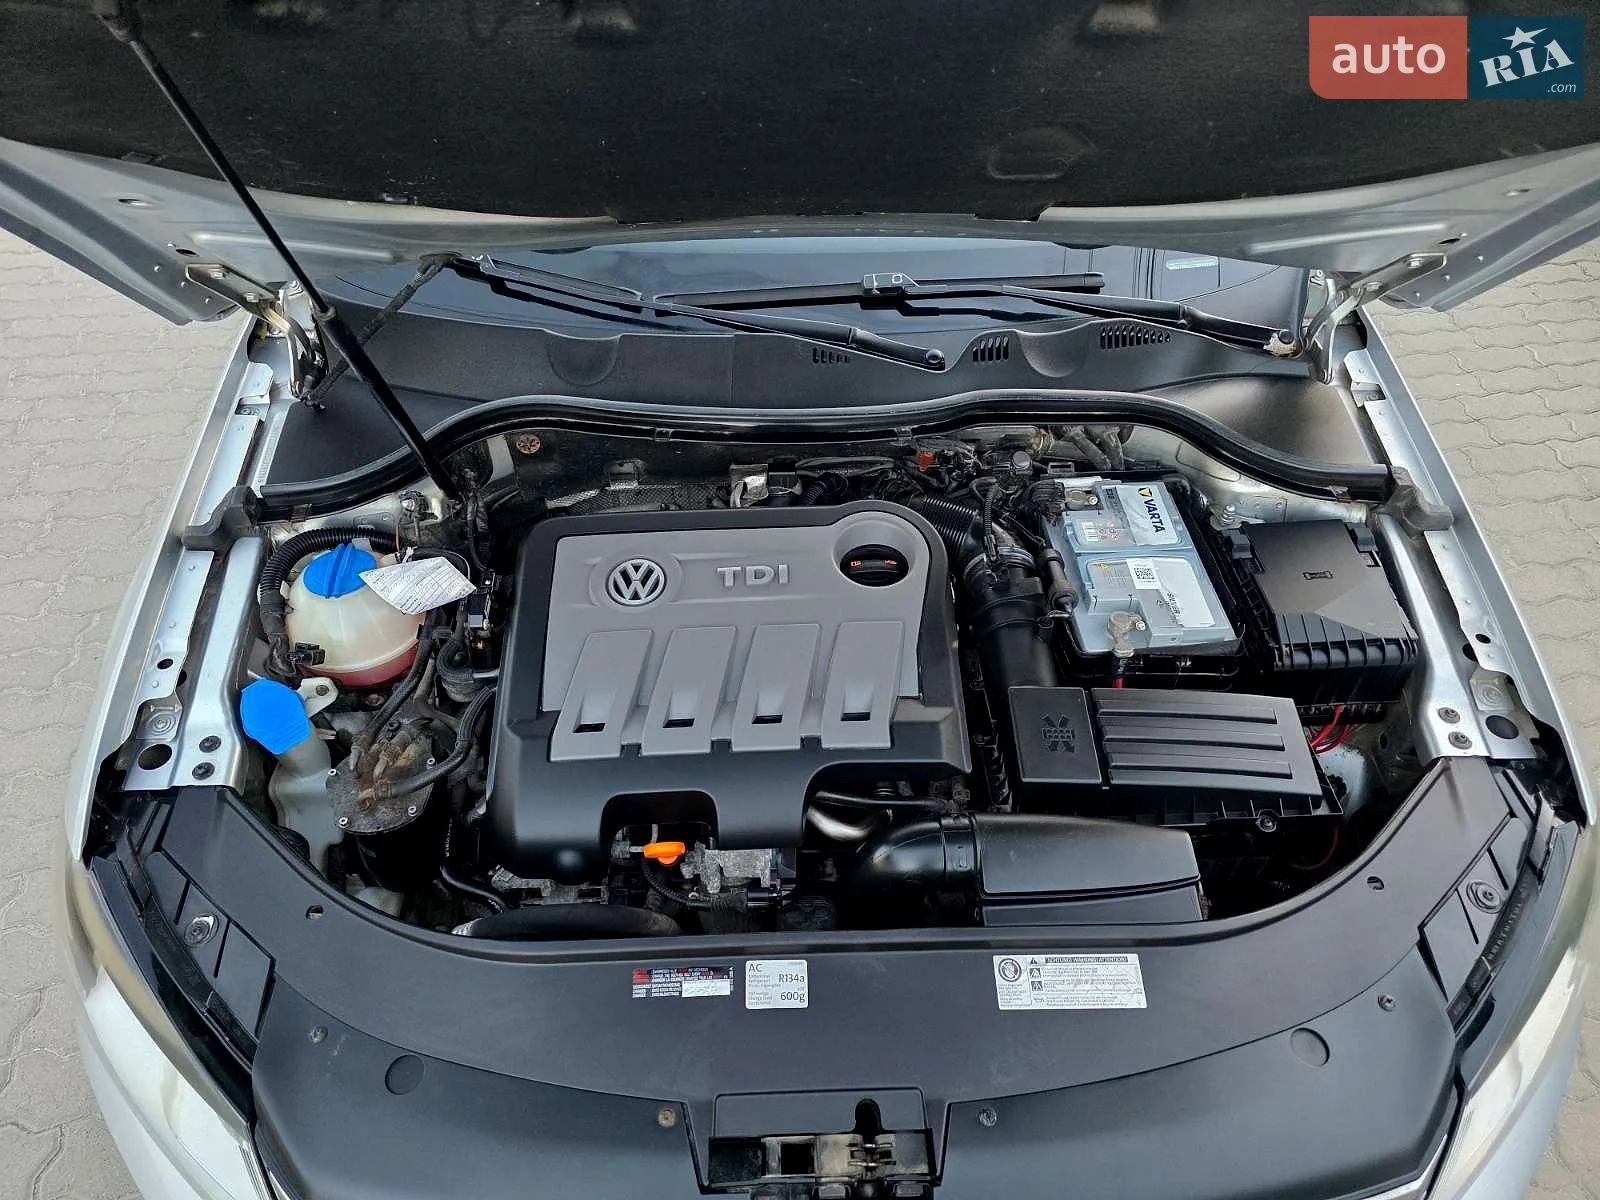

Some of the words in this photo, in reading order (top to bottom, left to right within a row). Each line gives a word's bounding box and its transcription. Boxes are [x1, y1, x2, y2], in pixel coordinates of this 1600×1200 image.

[1143, 498, 1166, 533] VARTA
[607, 558, 666, 606] VW
[717, 564, 790, 587] TDI
[749, 963, 763, 972] AC
[778, 973, 805, 983] R134a
[780, 991, 806, 1004] 600g
